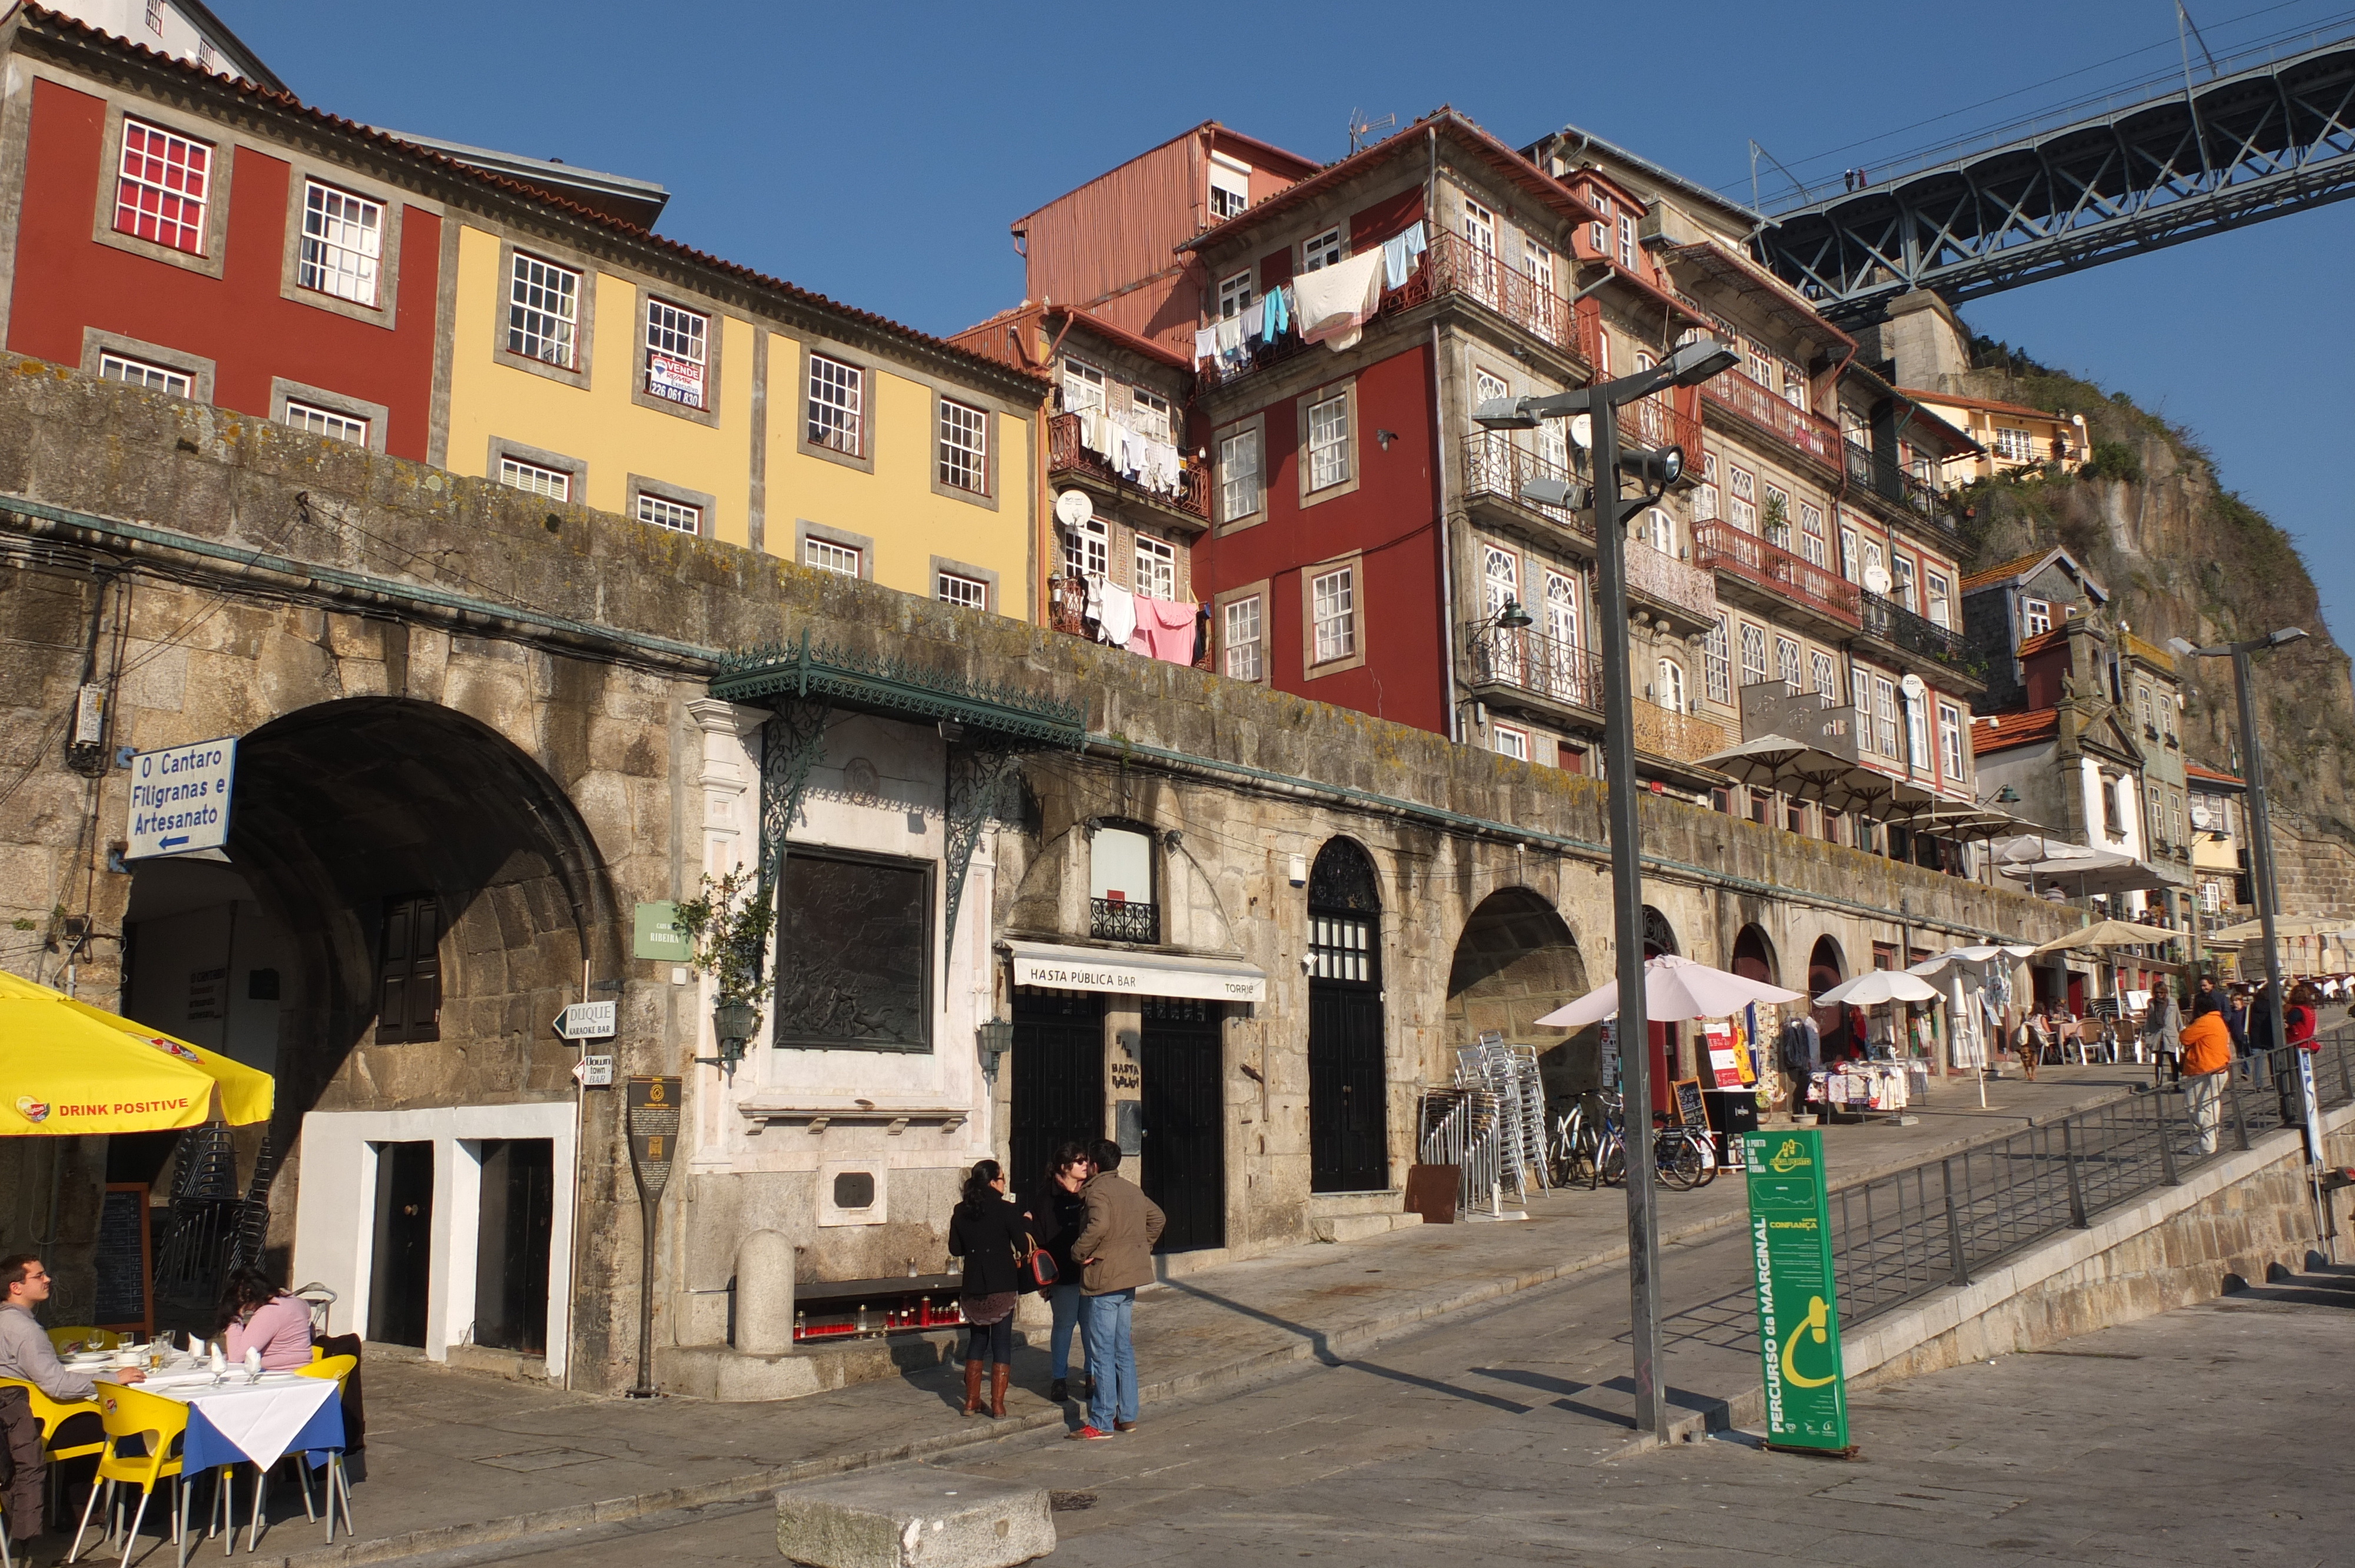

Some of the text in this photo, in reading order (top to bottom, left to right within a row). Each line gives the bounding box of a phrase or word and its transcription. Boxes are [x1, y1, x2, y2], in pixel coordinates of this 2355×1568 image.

[667, 361, 699, 380] VENDE
[651, 383, 698, 406] 226 061 830
[672, 380, 698, 393] Executivo
[142, 749, 222, 778] O Cantaro
[132, 778, 225, 809] Filigranas e
[134, 804, 218, 836] Artesanato
[651, 932, 679, 943] RIBEIRA
[1031, 969, 1136, 987] HASTA PÚBLICA BAR
[570, 1006, 611, 1024] DUQUE
[569, 1026, 595, 1035] KARAOKE
[586, 1057, 611, 1066] Down
[59, 1104, 108, 1116] DRINK
[114, 1098, 188, 1114] POSITIVE
[1769, 1221, 1817, 1231] CONFIANÇA
[1754, 1218, 1784, 1433] PERCURSO da MARGINAL
